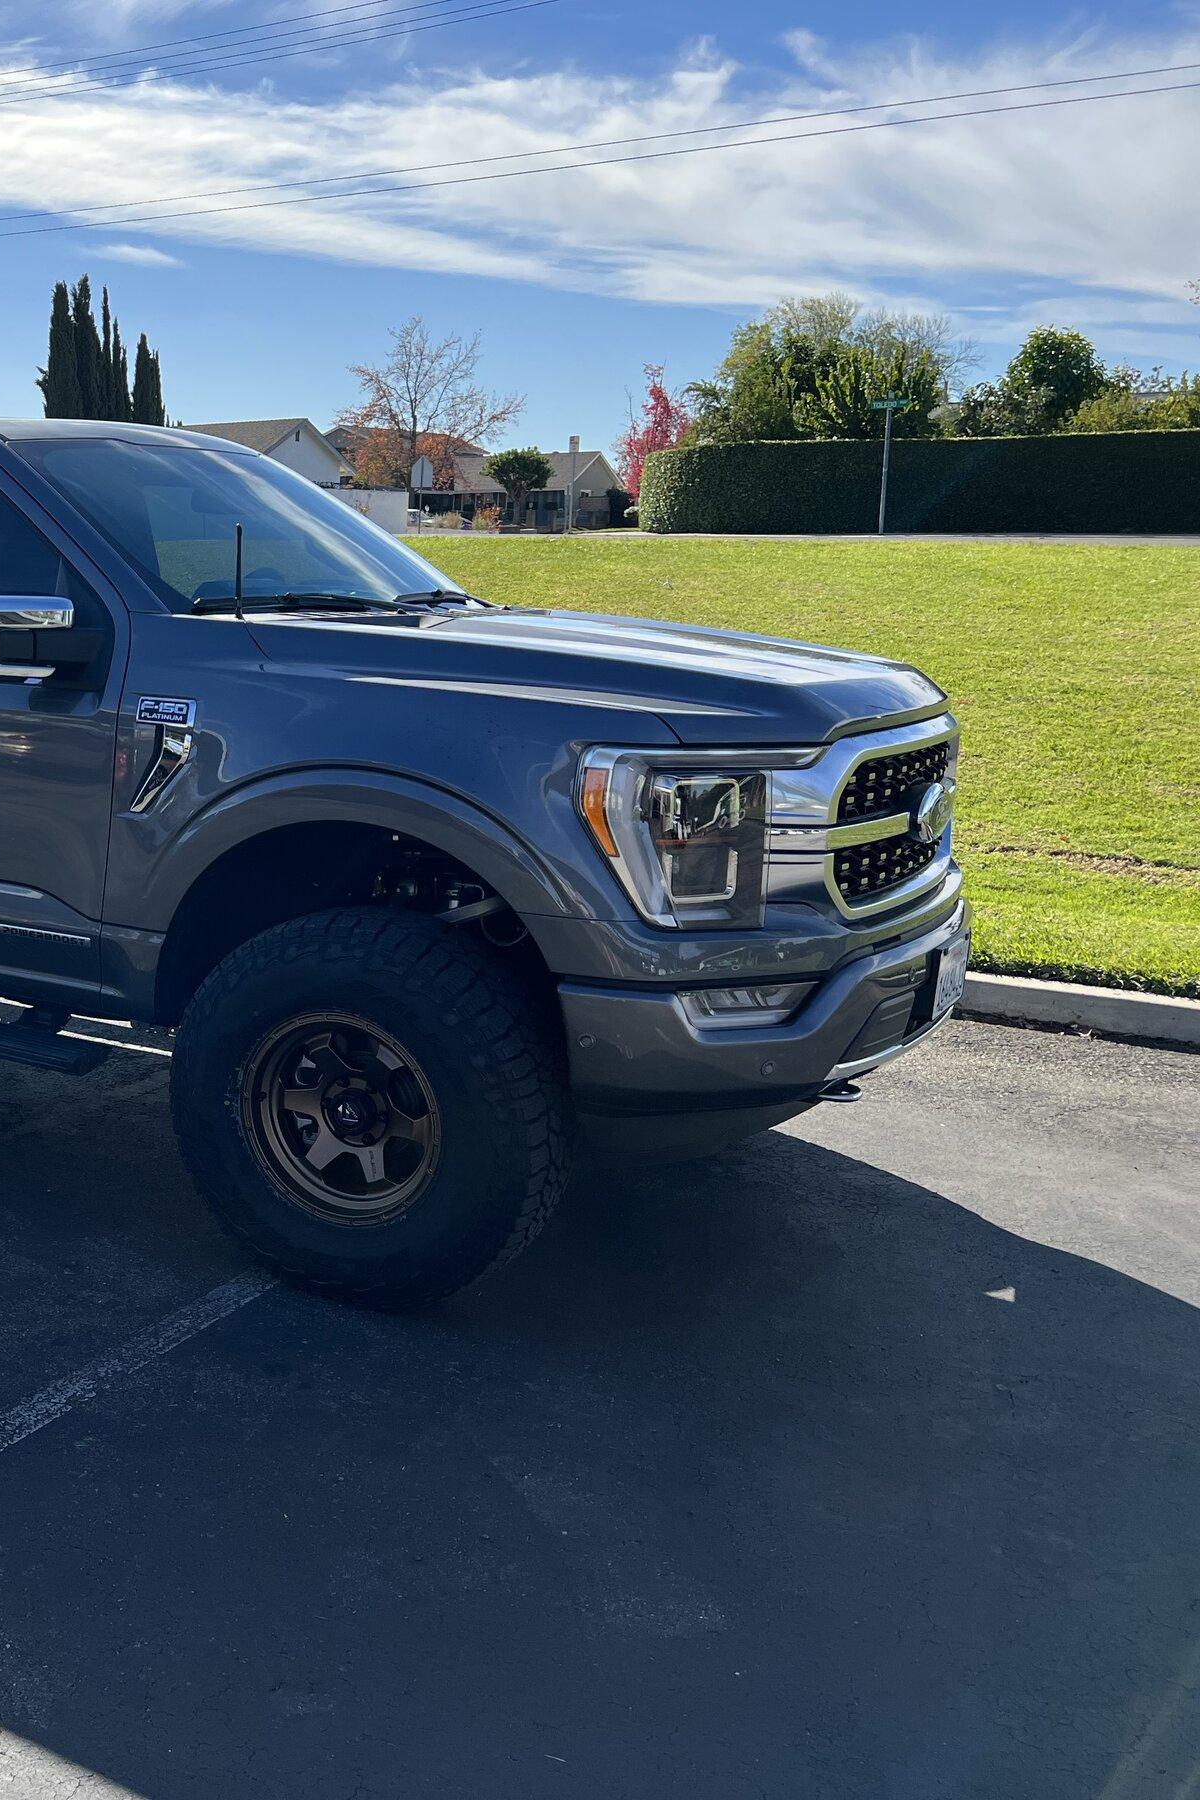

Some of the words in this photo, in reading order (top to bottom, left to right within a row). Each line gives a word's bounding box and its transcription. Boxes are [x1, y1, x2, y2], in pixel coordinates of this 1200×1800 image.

[872, 400, 897, 409] TOLEDO
[141, 700, 187, 714] F-150
[141, 712, 183, 722] PLATINUM
[2, 926, 86, 946] POWERBOOST
